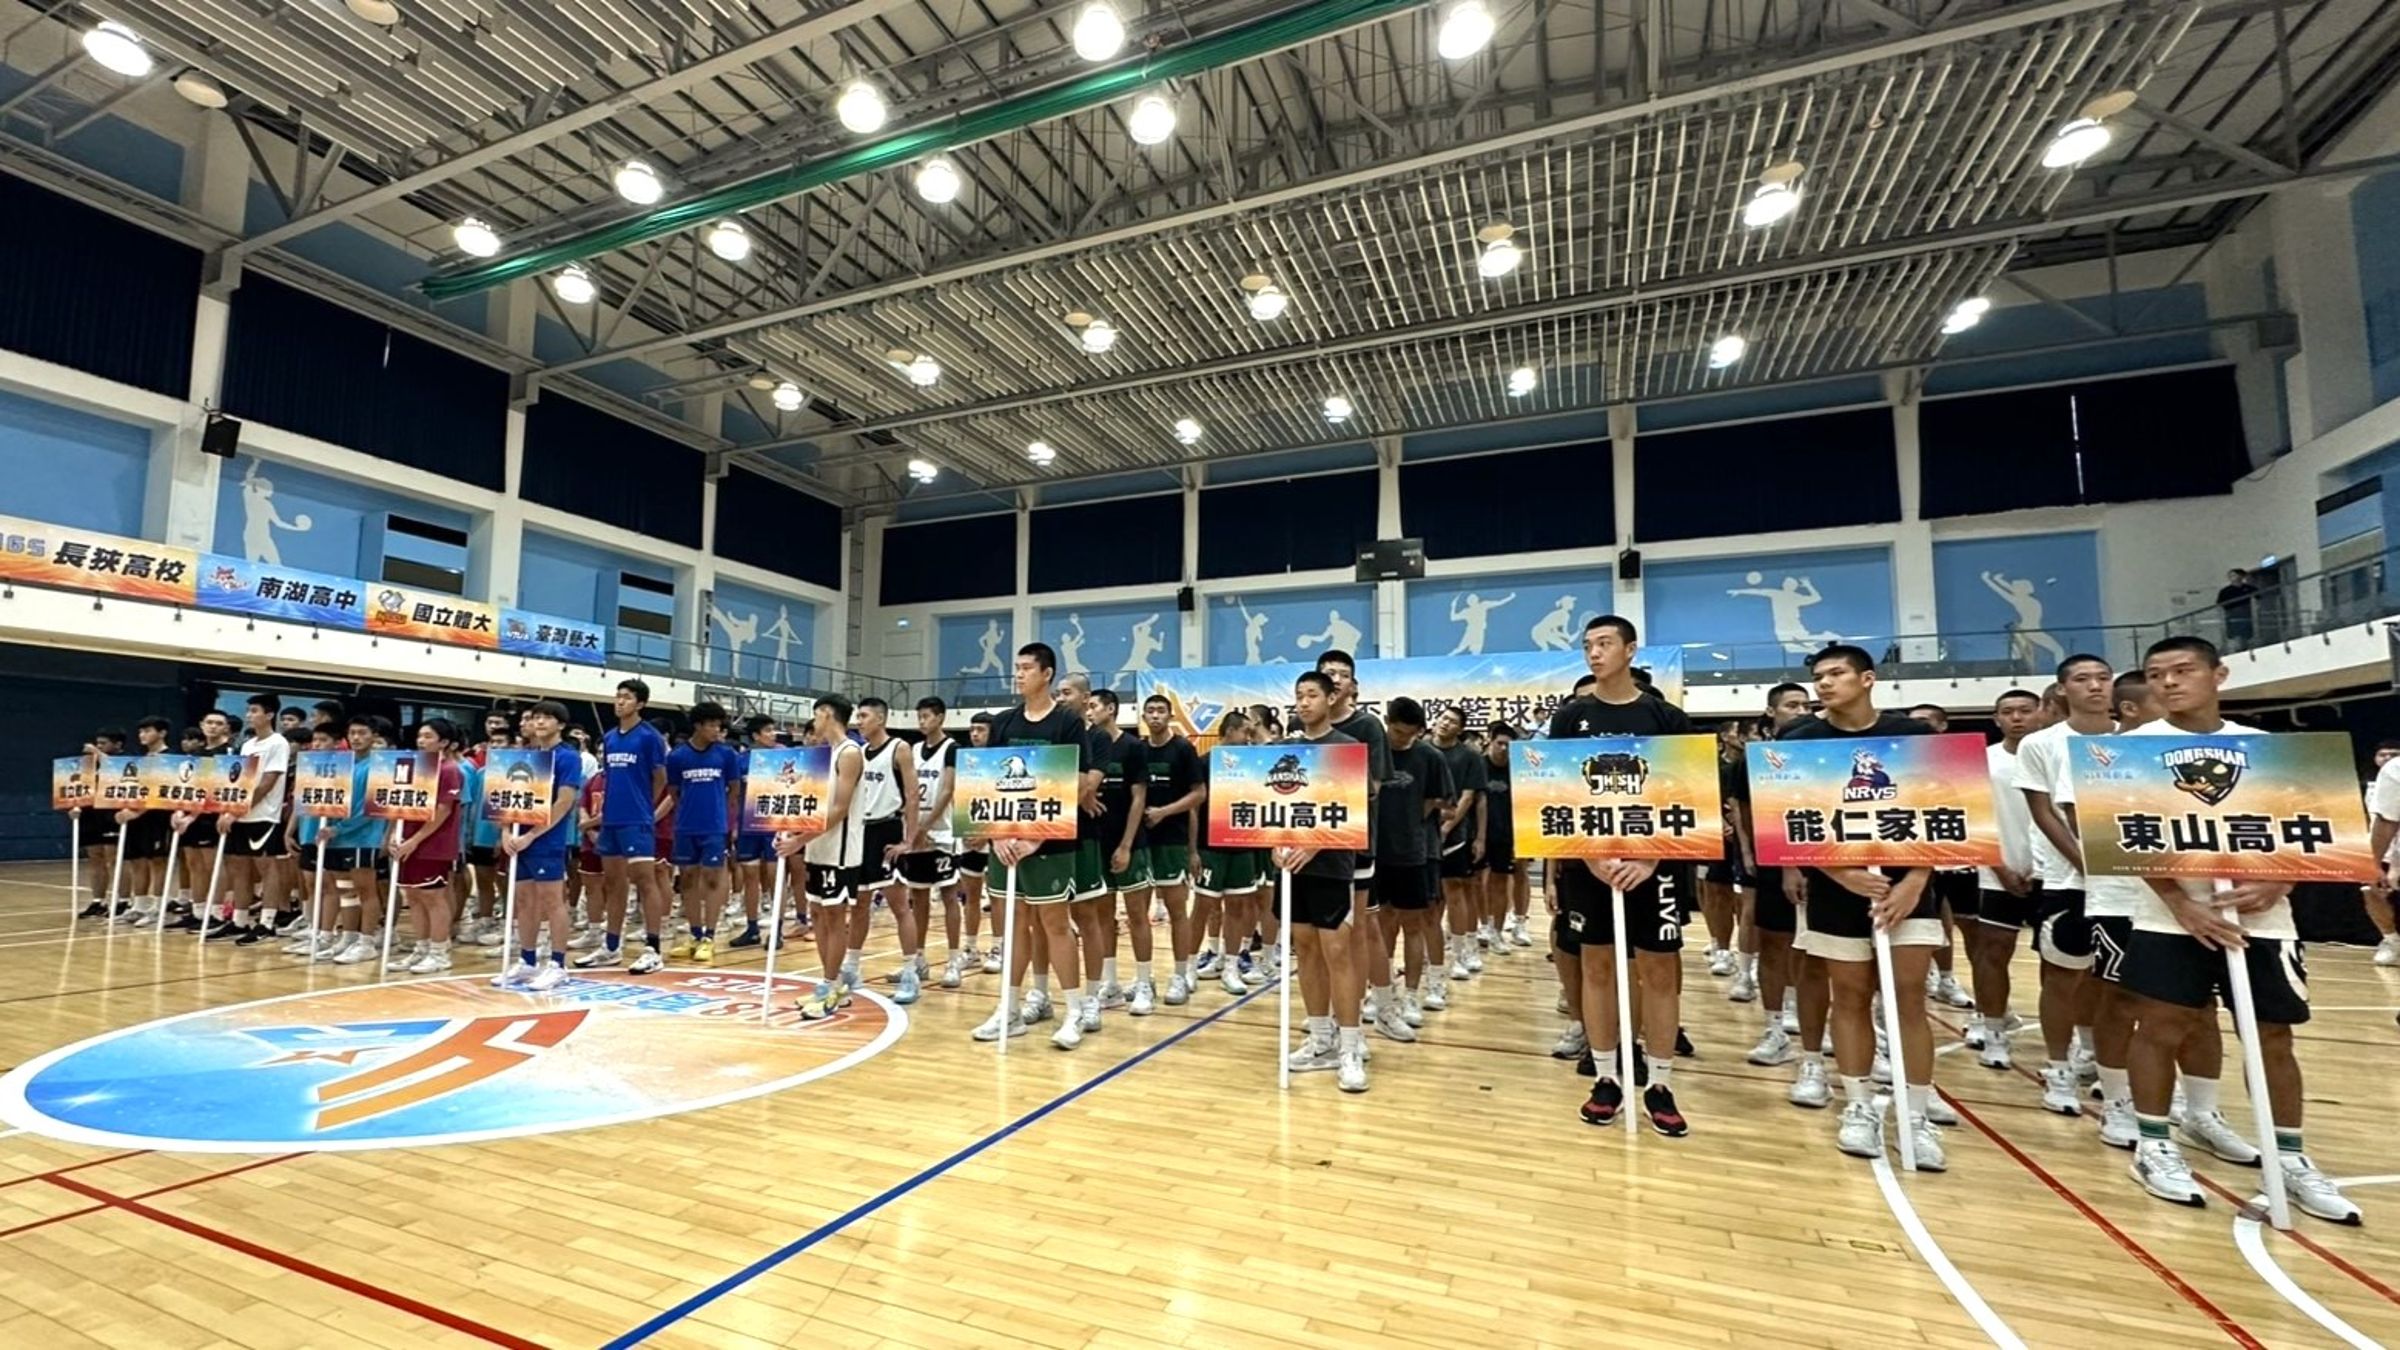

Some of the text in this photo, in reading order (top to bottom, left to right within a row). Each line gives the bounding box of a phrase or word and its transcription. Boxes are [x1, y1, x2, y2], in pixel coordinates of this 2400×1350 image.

[256, 577, 358, 610] 南湖高中
[412, 603, 492, 632] 國立體大
[396, 764, 409, 782] M
[375, 788, 429, 808] 明成高校
[490, 789, 545, 810] 中部大第一
[756, 794, 818, 817] 南湖高中
[970, 797, 1062, 822] 松山高中
[1230, 801, 1348, 829] 南山高中
[1540, 804, 1696, 837] 錦和高中
[1785, 807, 1968, 842] 能仁家商
[2117, 814, 2334, 853] 東山高中
[936, 857, 953, 872] 22
[822, 870, 836, 888] 14
